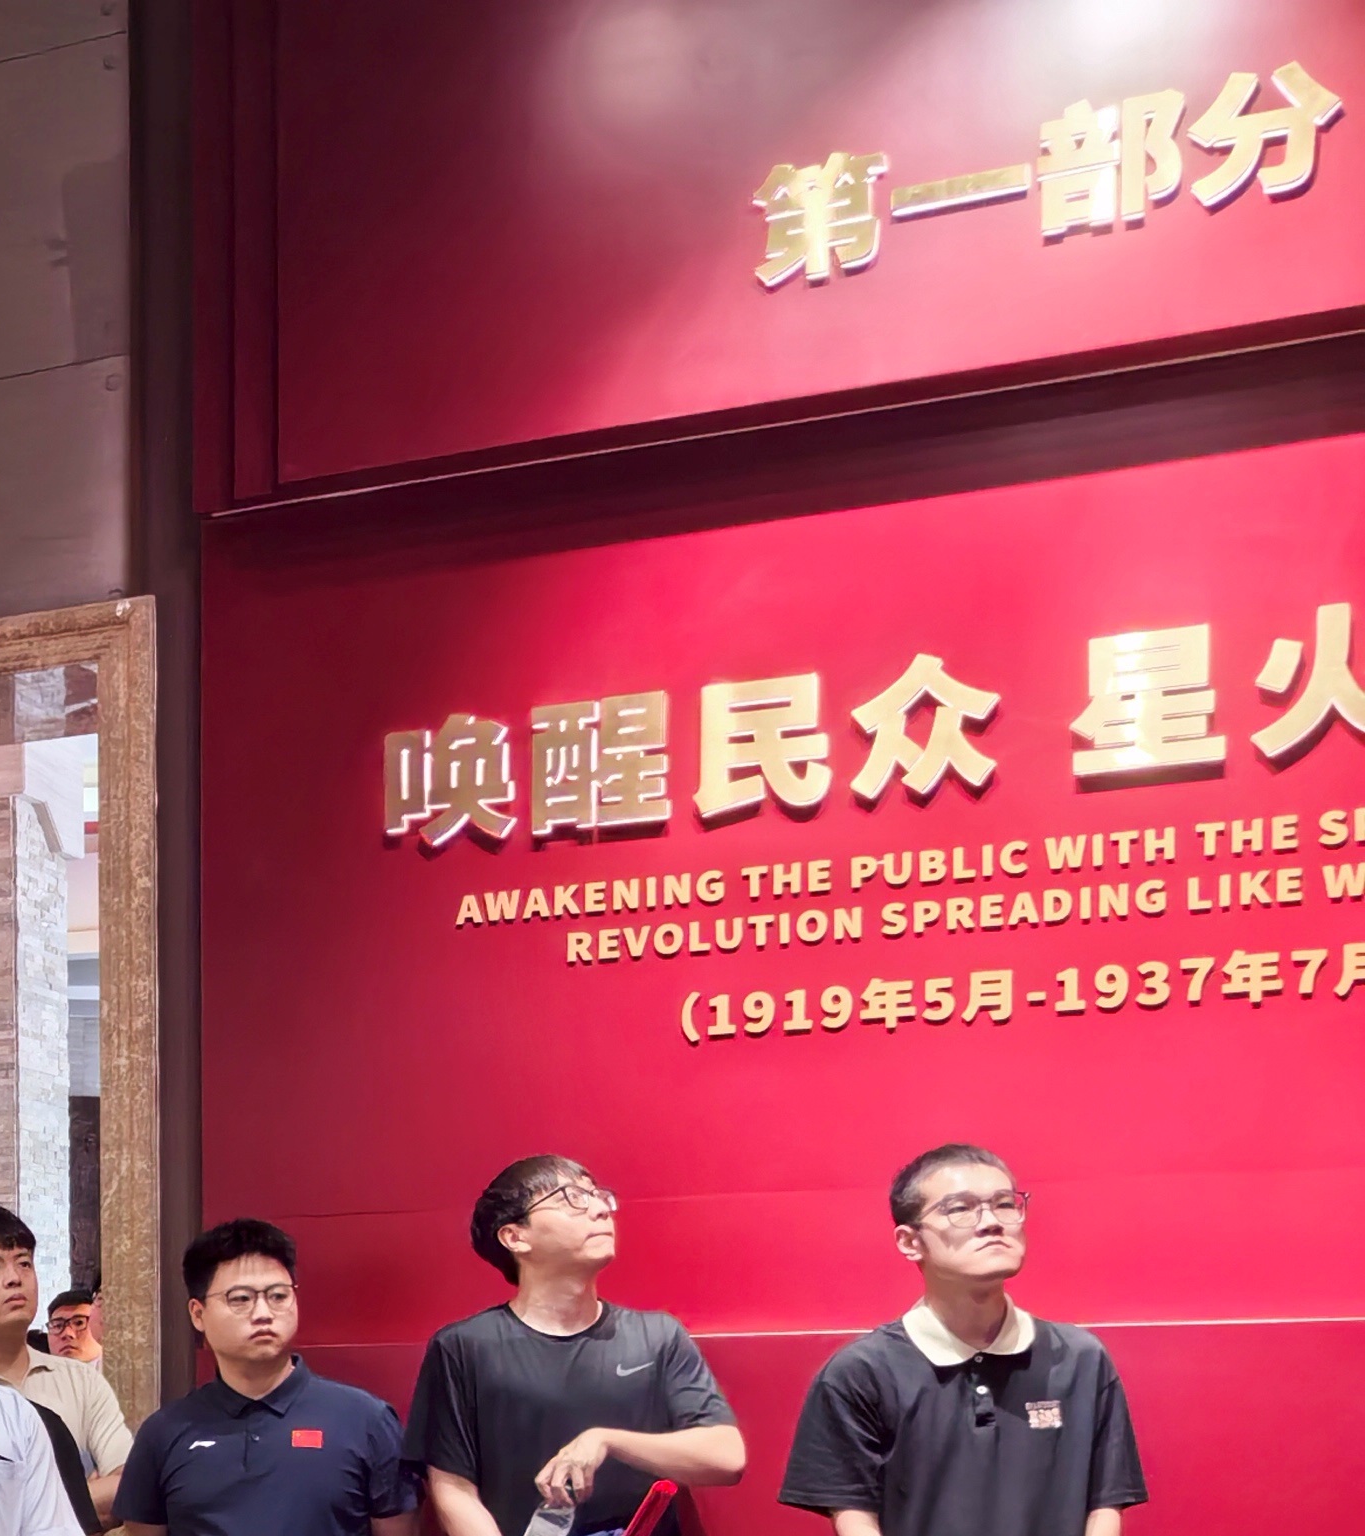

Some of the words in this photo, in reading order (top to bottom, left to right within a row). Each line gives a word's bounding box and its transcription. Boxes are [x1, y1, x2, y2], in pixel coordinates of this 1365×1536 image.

[752, 60, 1343, 288] 第一部分
[383, 652, 1000, 850] 唤醒民众
[1070, 602, 1365, 785] 星火
[455, 869, 726, 928] AWAKENING
[741, 859, 832, 900] THE
[850, 840, 1029, 889] PUBLIC
[1044, 826, 1176, 873] WITH
[1195, 813, 1300, 857] THE
[567, 905, 863, 965] REVOLUTION
[881, 879, 1167, 938] SPREADING
[1187, 867, 1304, 913] LIKE
